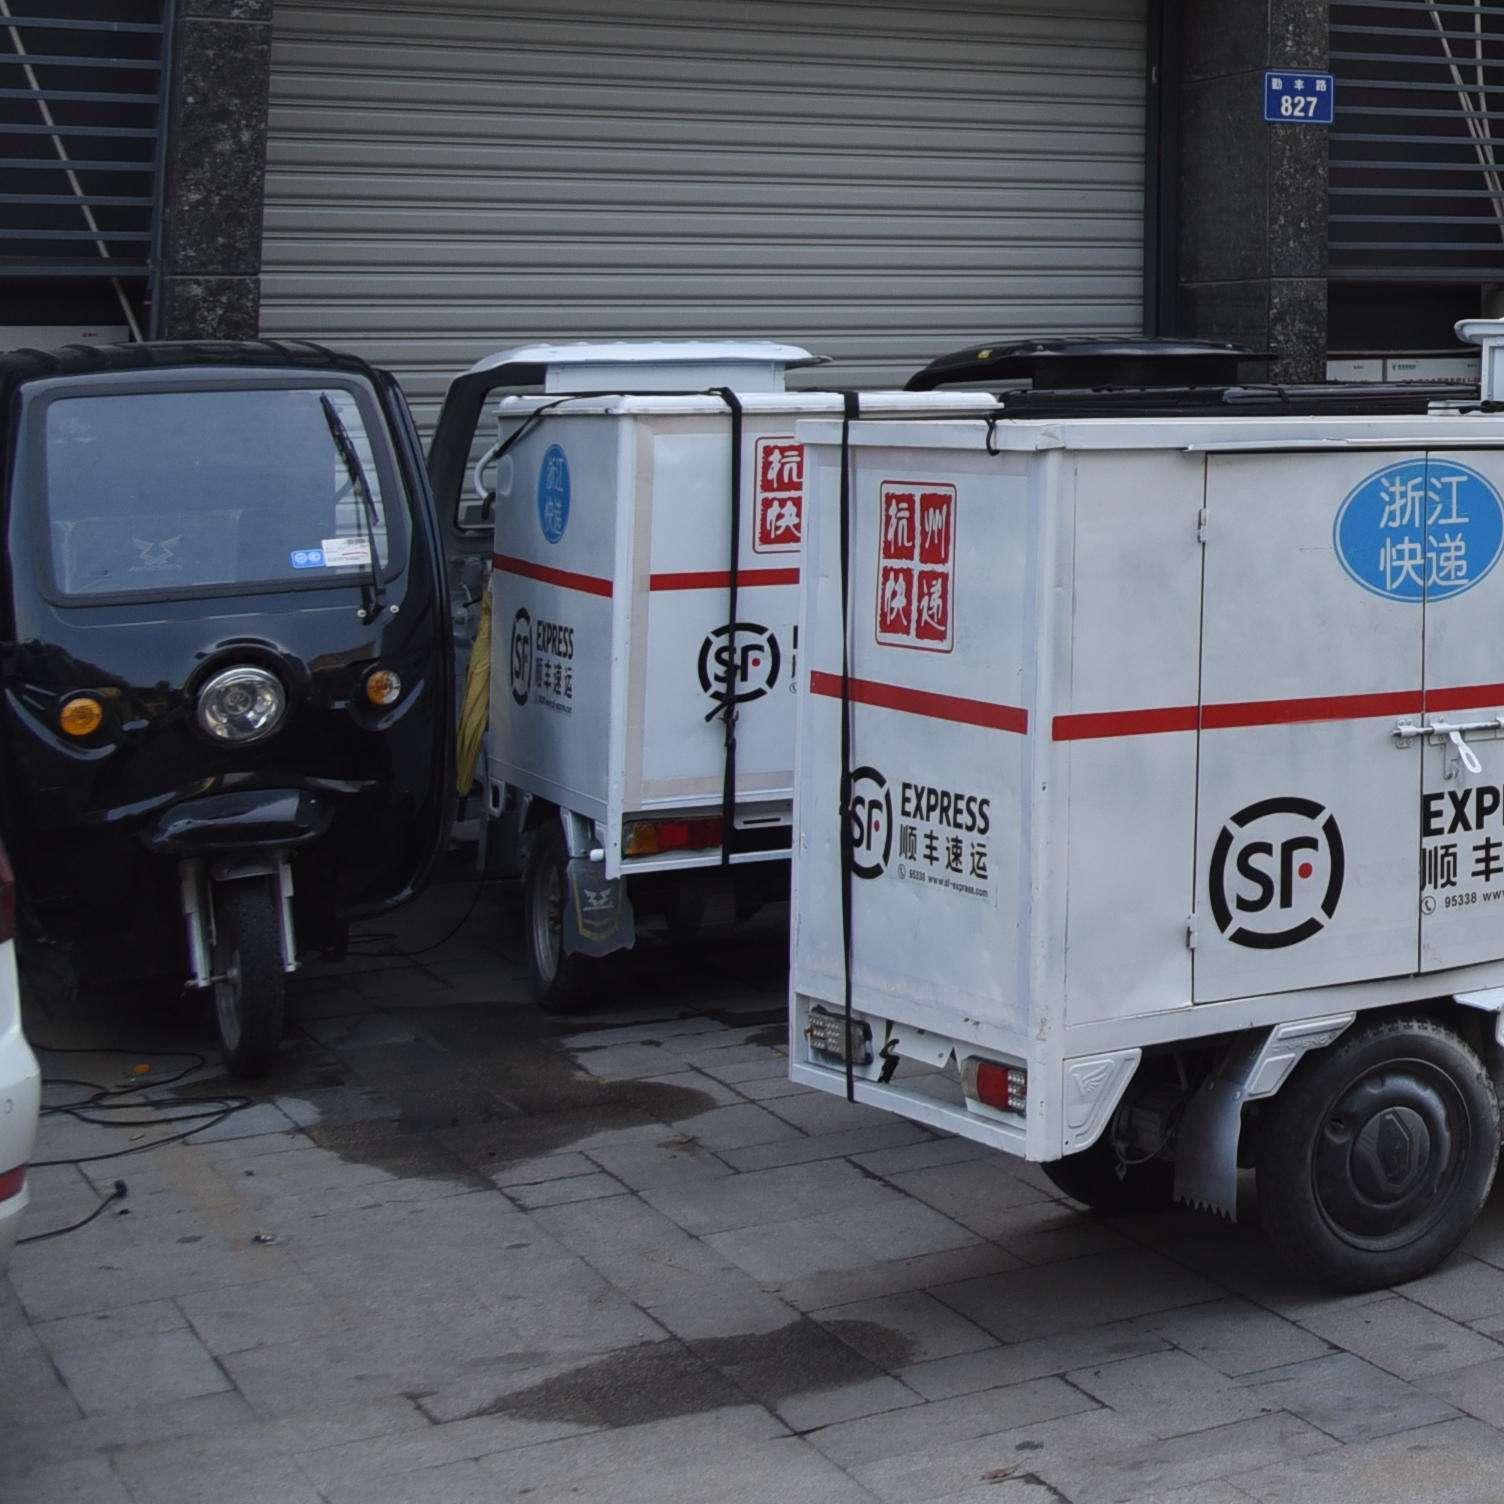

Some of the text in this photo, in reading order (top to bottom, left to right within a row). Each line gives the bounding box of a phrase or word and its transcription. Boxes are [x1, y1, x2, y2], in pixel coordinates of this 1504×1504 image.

[1280, 95, 1318, 117] 827
[886, 498, 949, 559] 杭州
[1378, 475, 1470, 529] 浙江
[1379, 533, 1470, 592] 快递
[884, 570, 947, 631] 快递
[536, 619, 575, 660] EXPRESS
[850, 795, 884, 852] SF
[901, 782, 991, 836] EXPRESS
[899, 823, 989, 880] 顺丰速运
[1236, 836, 1319, 913] SF
[1444, 892, 1478, 909] 95338
